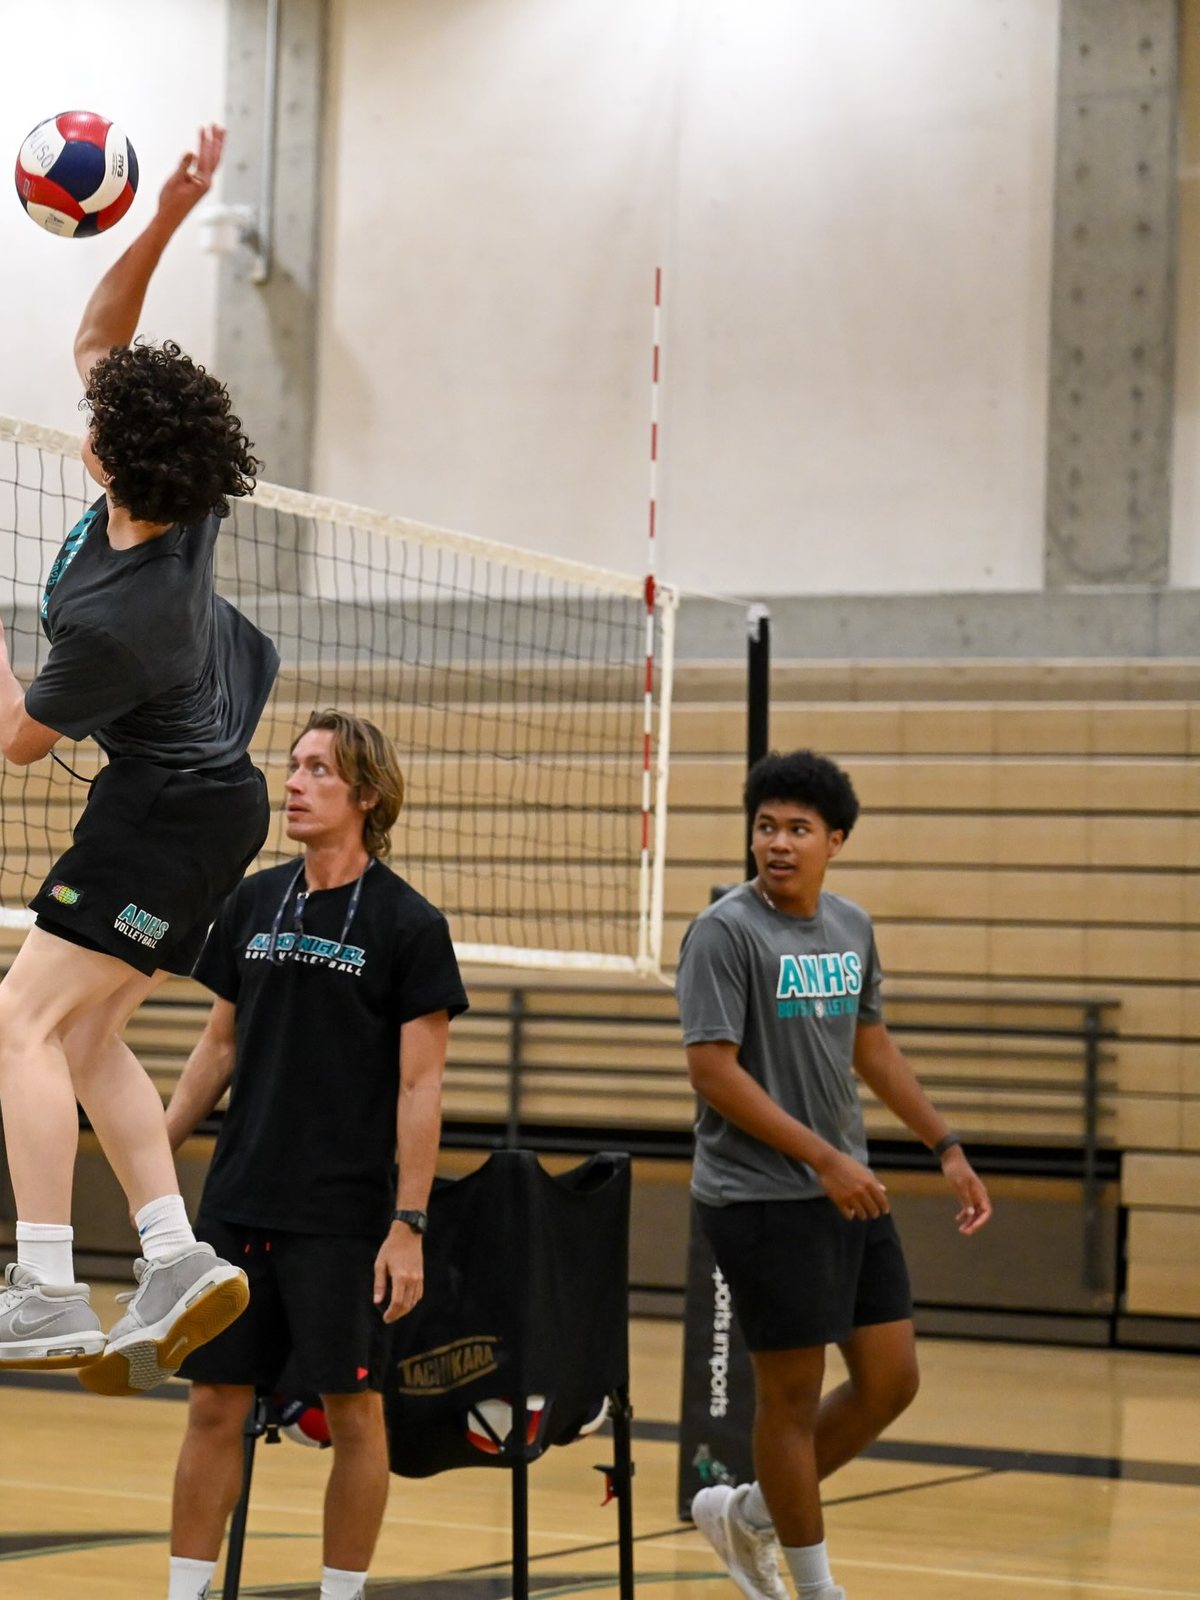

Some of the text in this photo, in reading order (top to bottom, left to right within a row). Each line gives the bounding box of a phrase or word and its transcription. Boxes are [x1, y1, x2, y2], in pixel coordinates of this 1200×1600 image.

[113, 918, 158, 949] VOLLEYBALL
[117, 903, 170, 940] ANHS
[245, 950, 362, 977] BOY VLLEBALL
[776, 951, 862, 999] ANHS
[708, 1265, 733, 1418] ports imports
[399, 1343, 496, 1388] TACHIKARA
